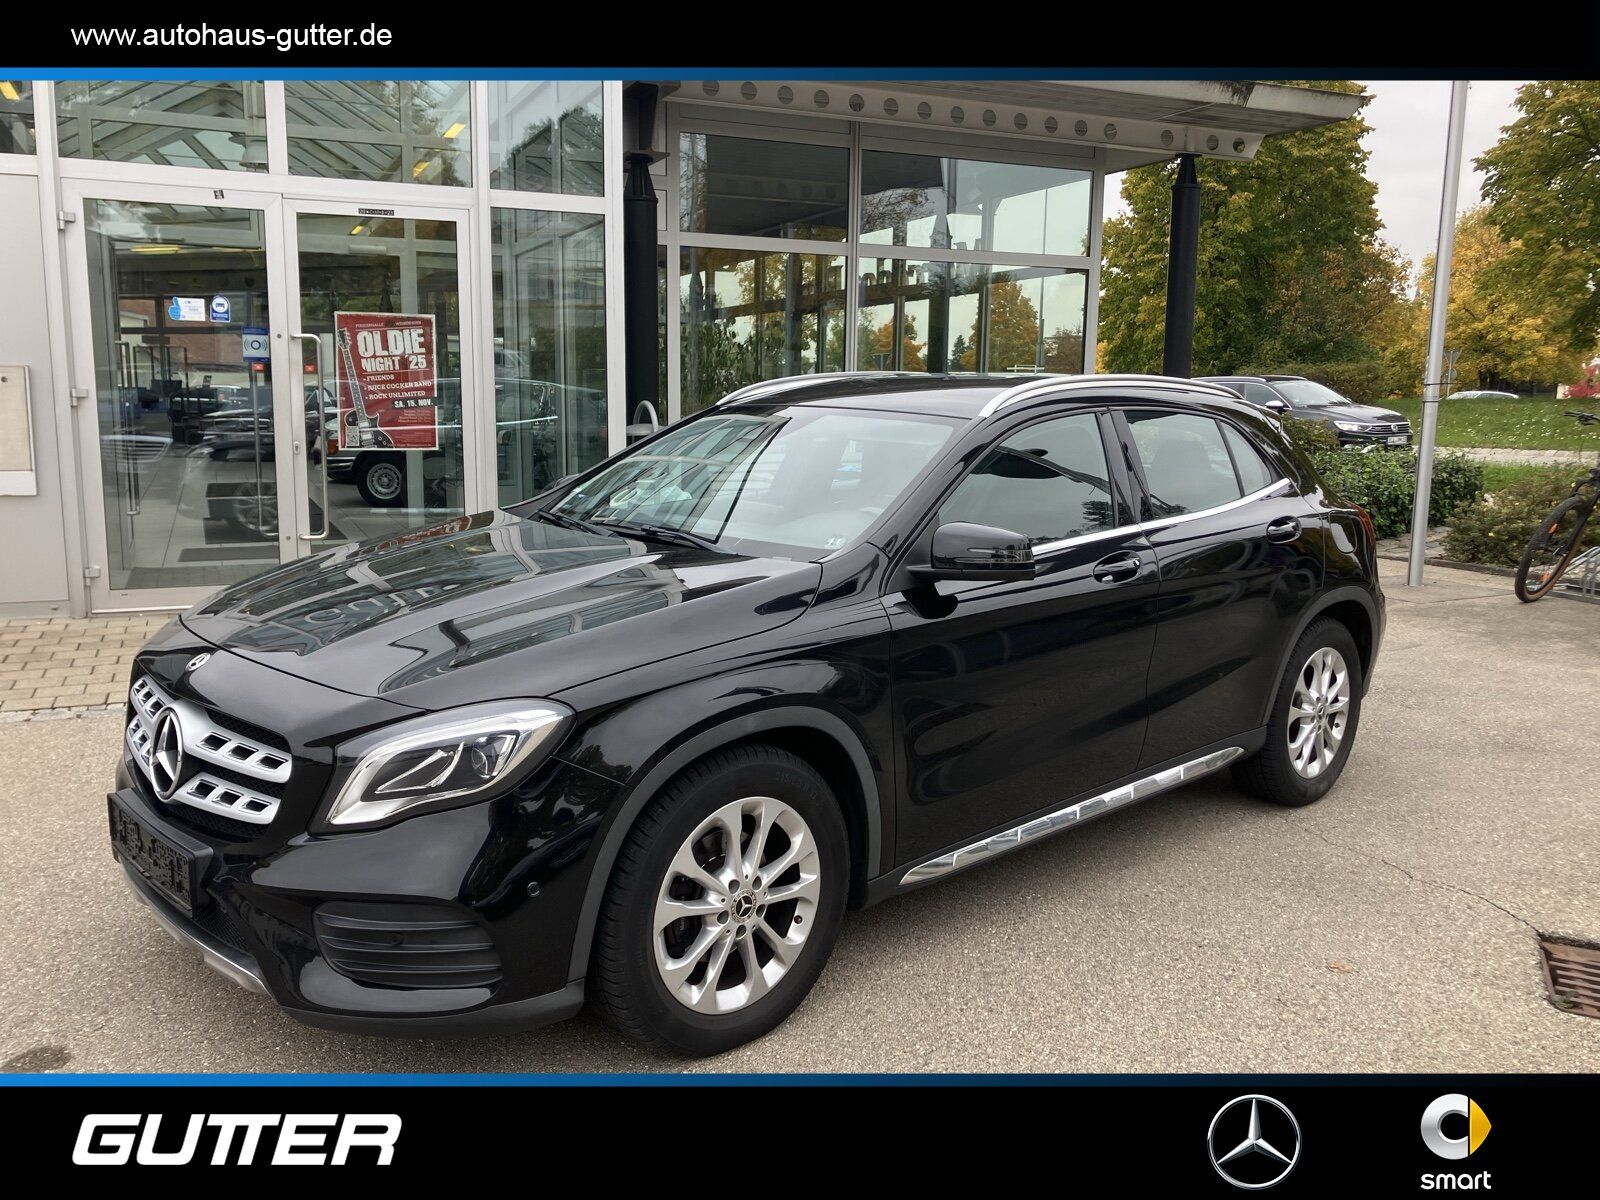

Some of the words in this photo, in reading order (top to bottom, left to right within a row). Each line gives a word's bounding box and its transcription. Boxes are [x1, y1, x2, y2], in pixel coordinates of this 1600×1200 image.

[356, 328, 426, 357] OLDIE
[361, 356, 400, 372] NIGHT
[386, 381, 413, 389] COCKER
[388, 390, 426, 399] UNLIMITED
[418, 398, 434, 407] NOV.
